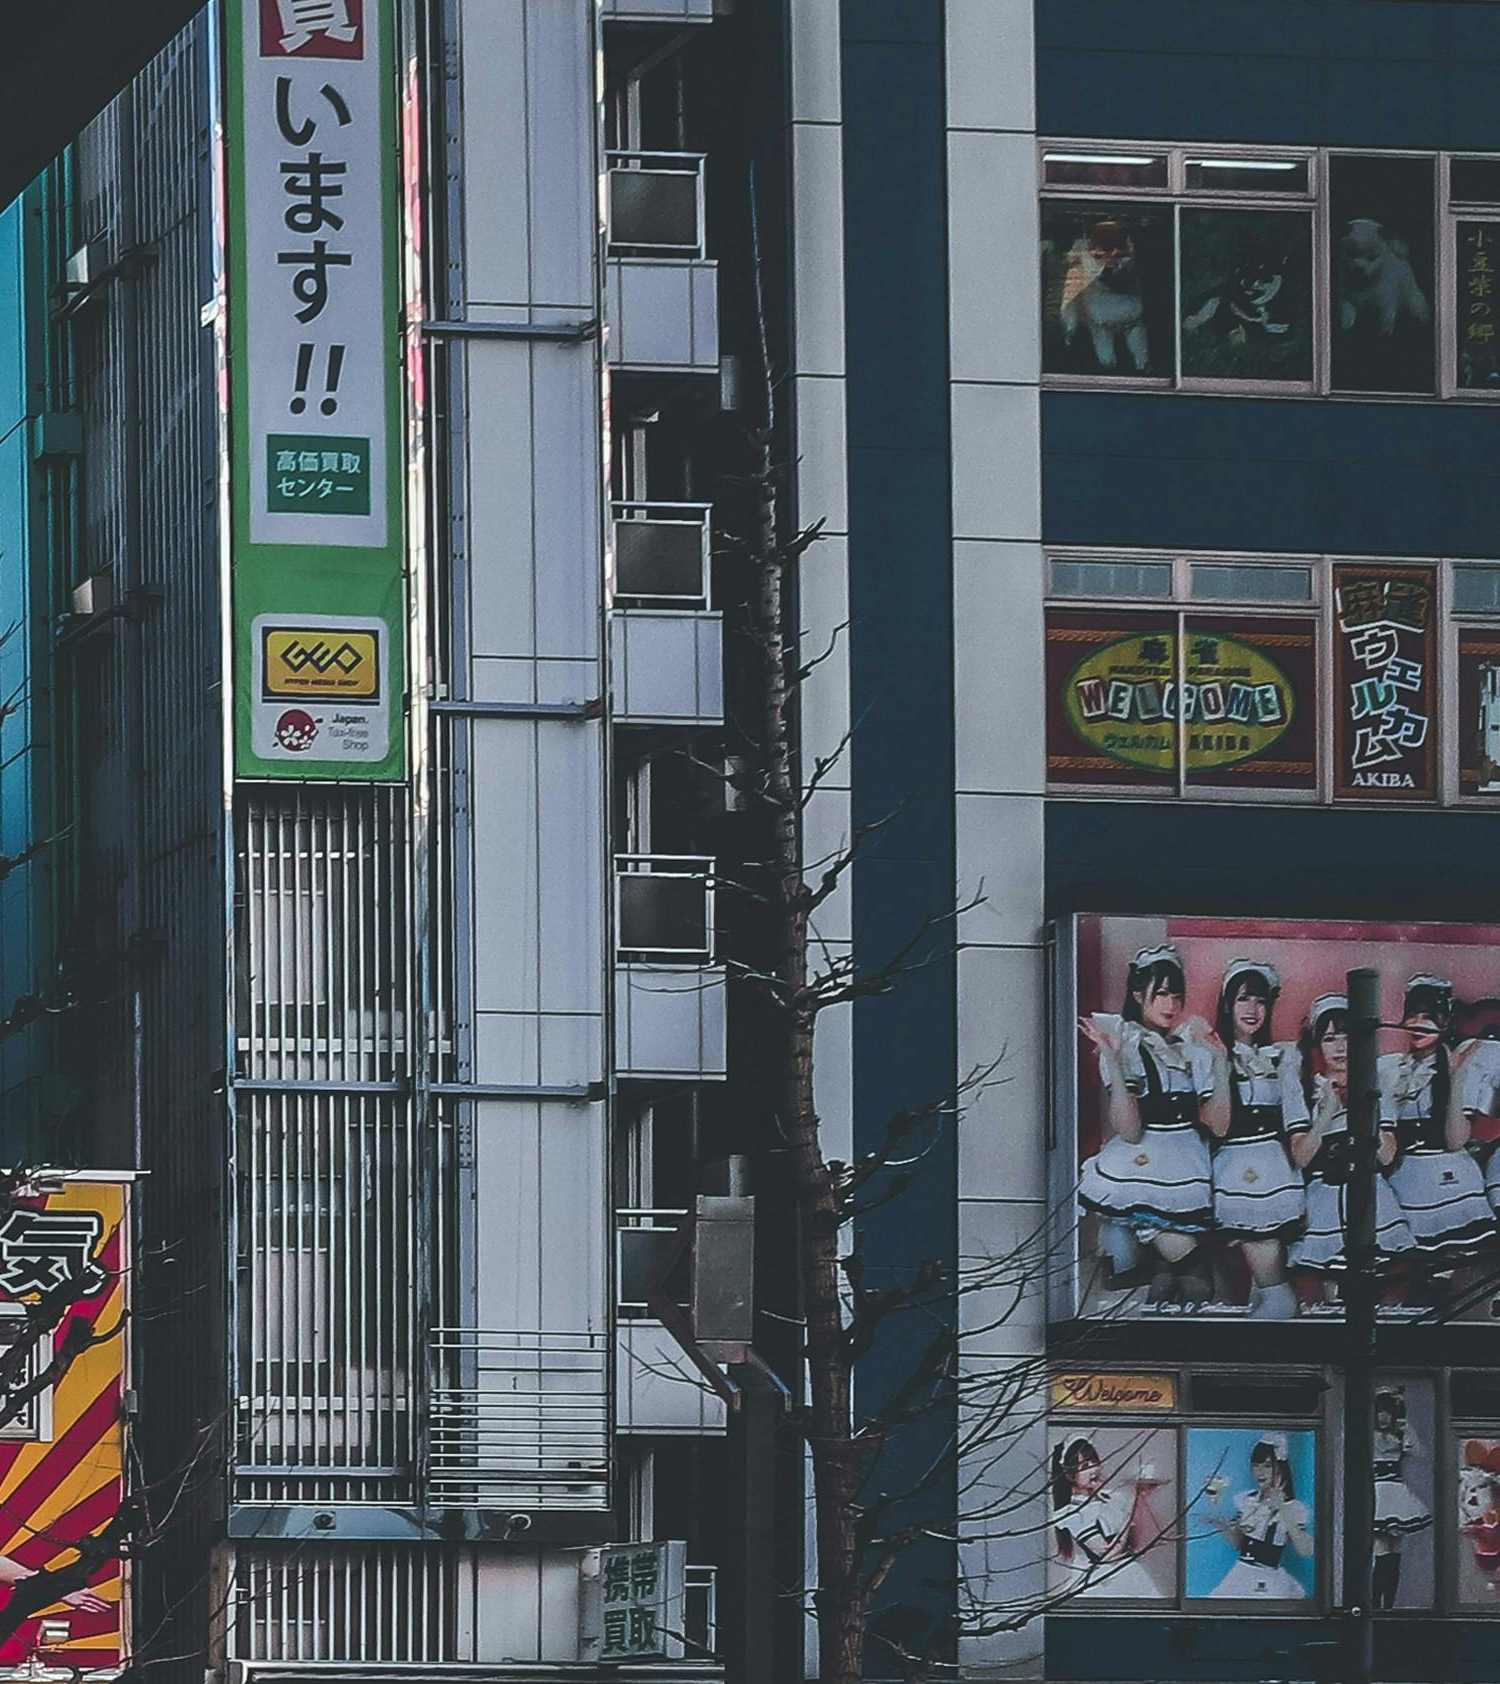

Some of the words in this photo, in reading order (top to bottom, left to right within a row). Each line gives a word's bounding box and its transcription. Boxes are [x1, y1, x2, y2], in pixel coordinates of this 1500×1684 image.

[275, 449, 362, 474] 高価買取
[276, 477, 355, 498] センター
[279, 640, 364, 675] GEO
[1076, 678, 1283, 727] WELCOME
[342, 739, 369, 752] Shop
[1351, 772, 1416, 788] AKIBA
[603, 1550, 659, 1604] 携帯
[602, 1607, 658, 1655] 買取
